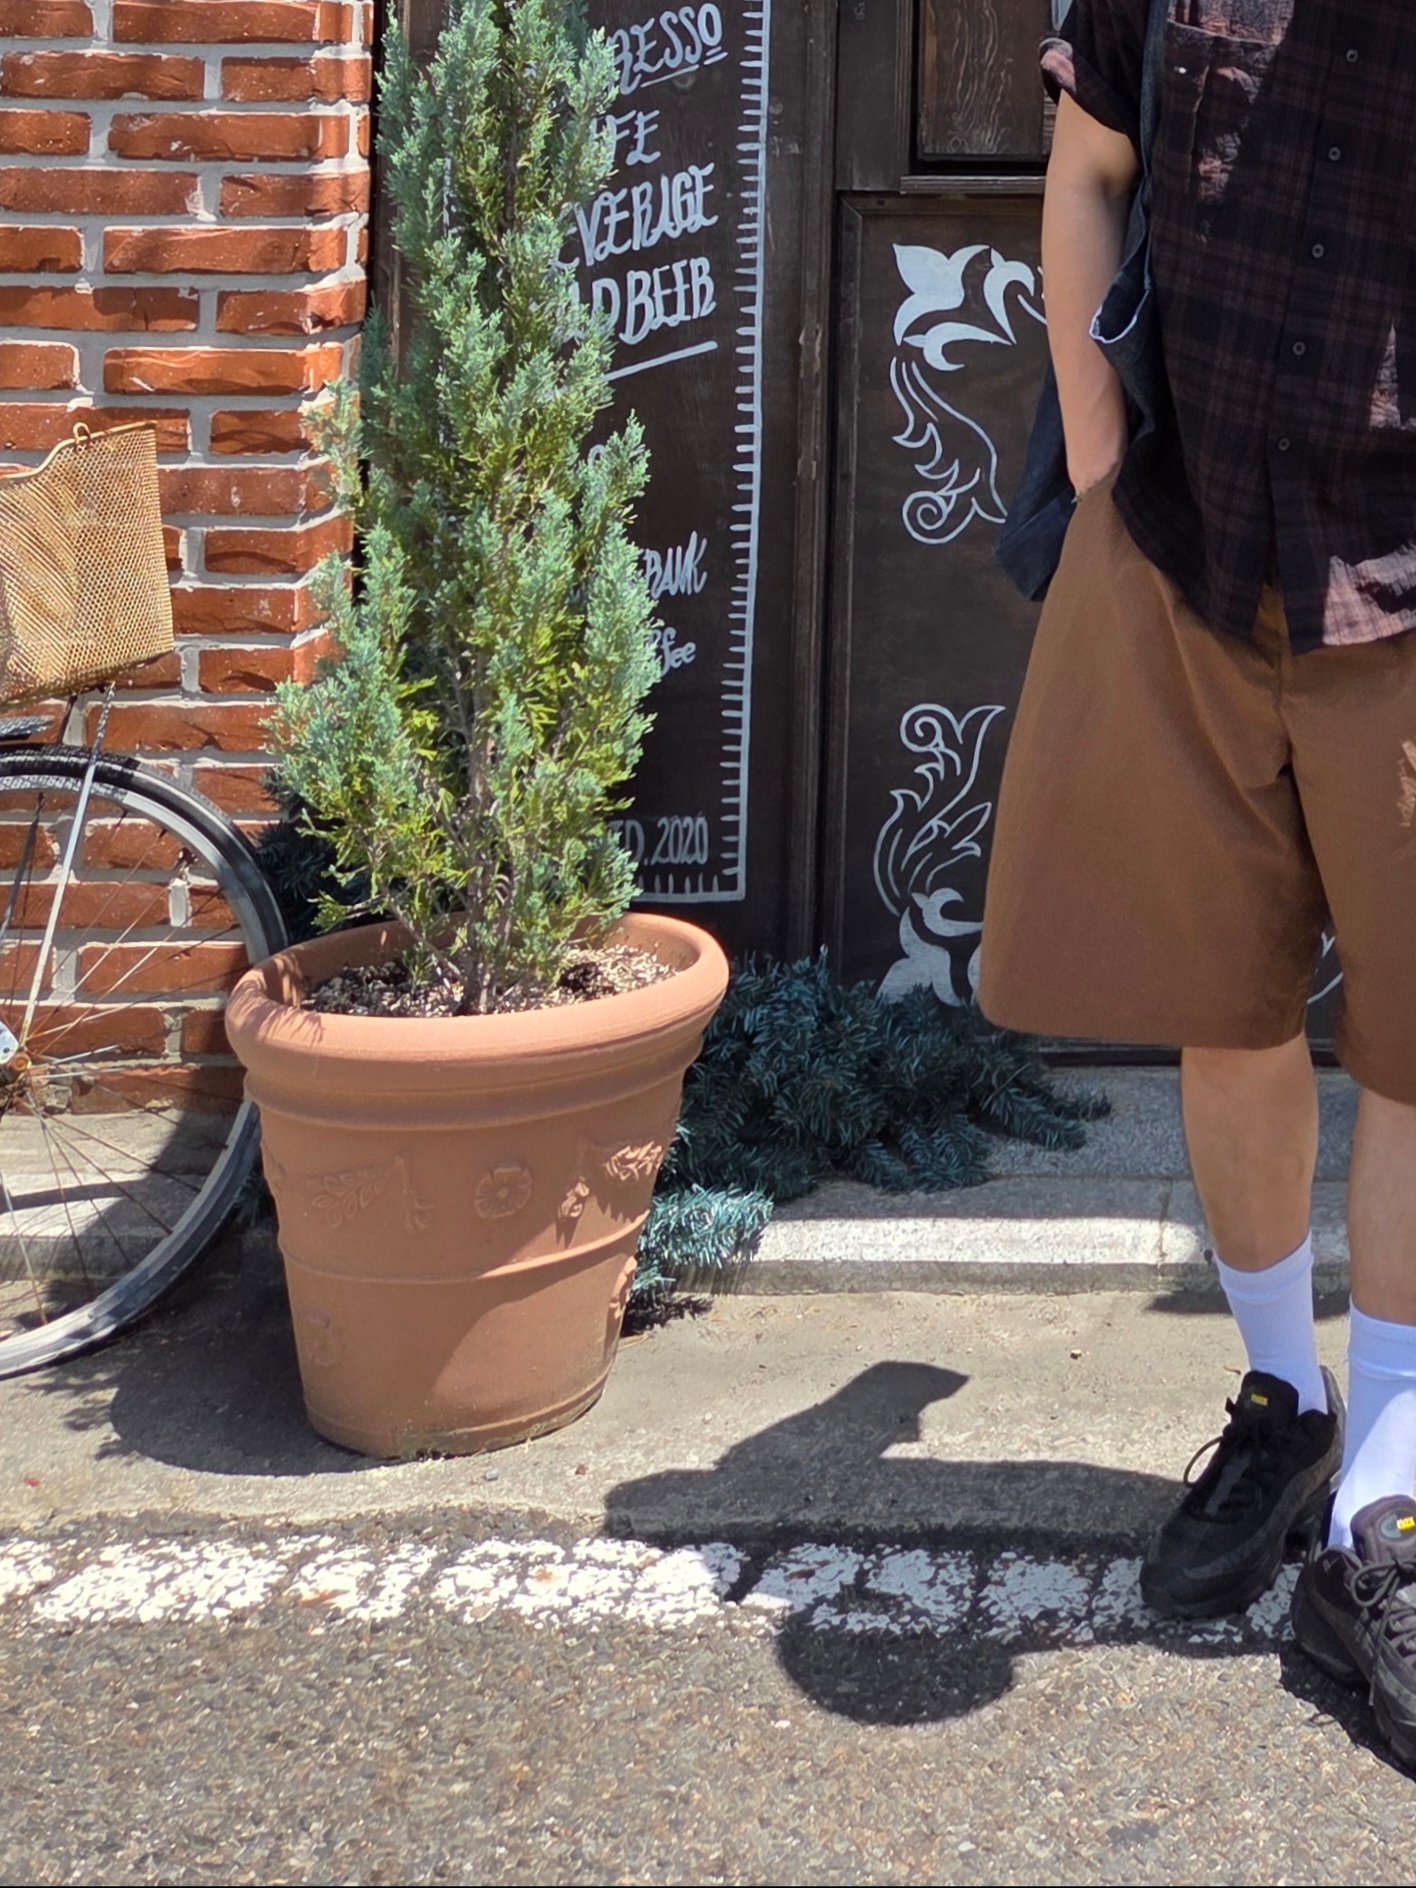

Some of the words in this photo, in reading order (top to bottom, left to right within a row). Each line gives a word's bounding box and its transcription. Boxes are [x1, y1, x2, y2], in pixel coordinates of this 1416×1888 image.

[606, 2, 724, 96] RESSO
[618, 255, 718, 345] BEER
[643, 530, 708, 600] RANK
